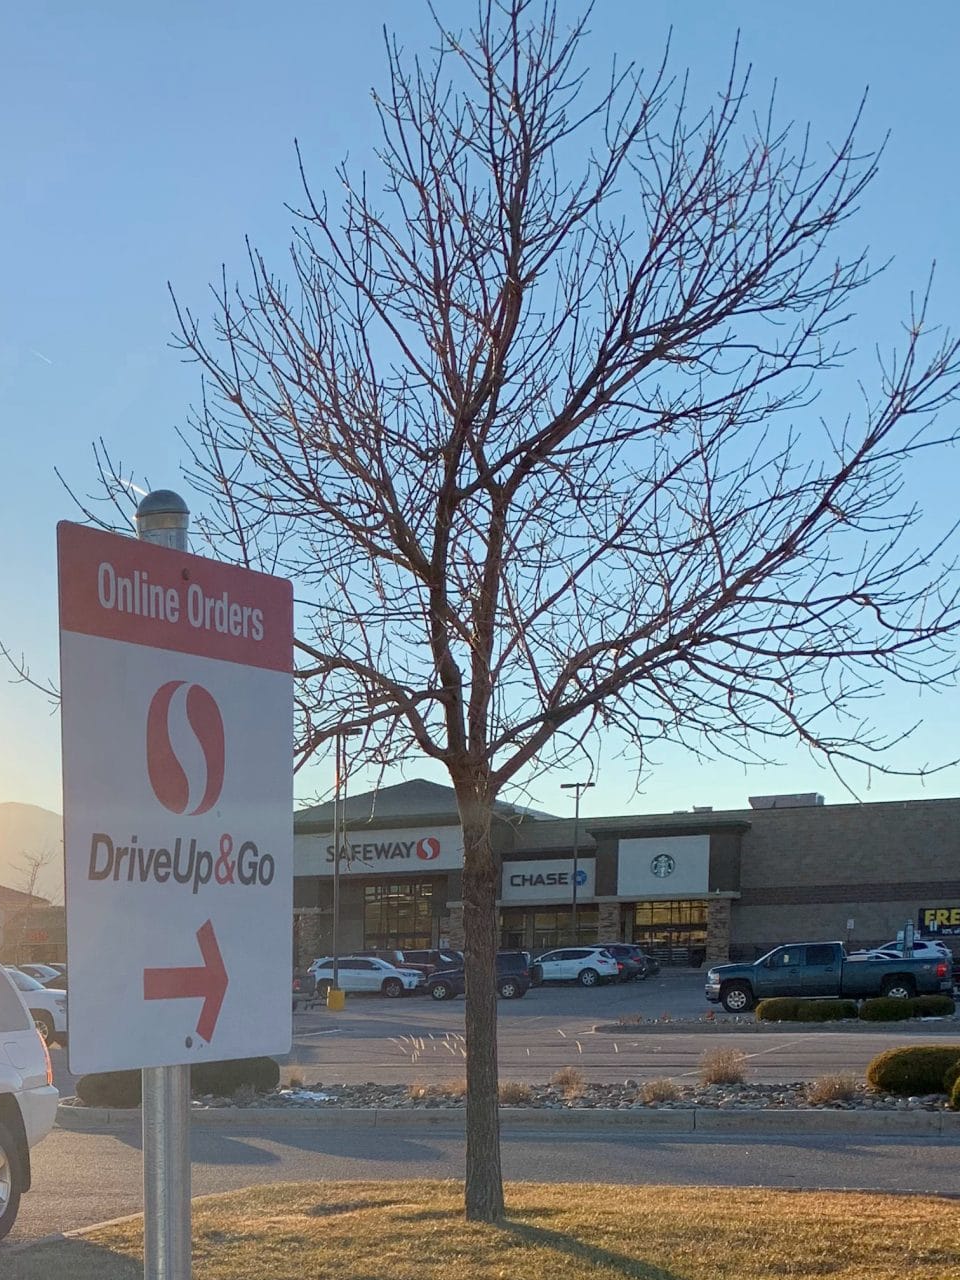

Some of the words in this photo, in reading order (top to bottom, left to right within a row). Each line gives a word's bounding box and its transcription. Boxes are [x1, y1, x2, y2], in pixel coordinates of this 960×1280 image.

[98, 562, 180, 623] Online
[187, 583, 264, 641] Orders
[88, 832, 275, 894] DriveUp&Go
[326, 841, 415, 863] SAFEWAY
[510, 873, 568, 887] CHASE
